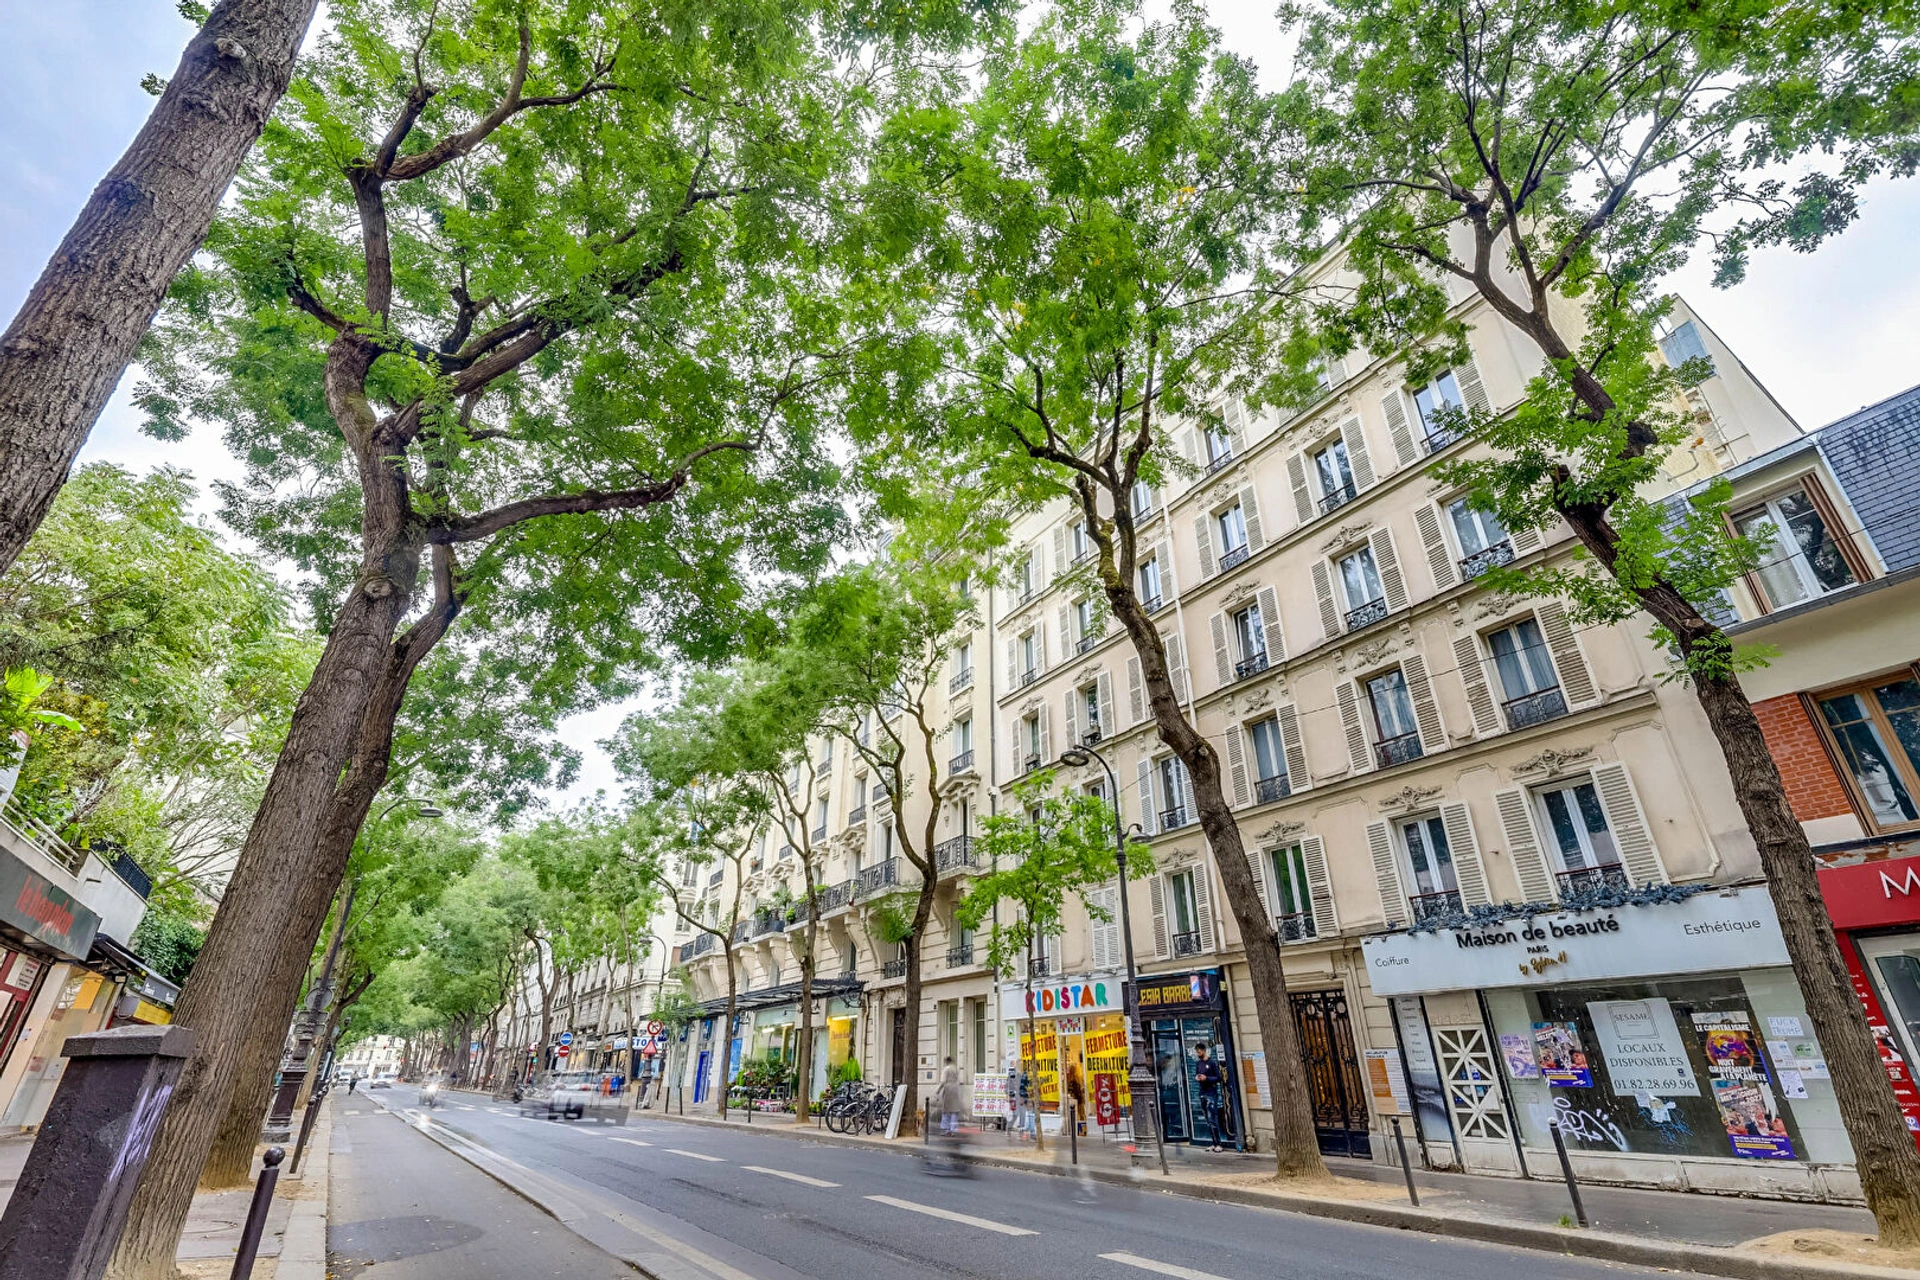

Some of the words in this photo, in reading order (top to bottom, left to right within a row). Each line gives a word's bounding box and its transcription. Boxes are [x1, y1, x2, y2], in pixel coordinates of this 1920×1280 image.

[1455, 930, 1517, 949] Maison
[1522, 925, 1546, 941] de
[1549, 914, 1620, 938] beauté
[1683, 919, 1762, 936] Esthétique
[1527, 945, 1549, 954] PARIS
[1375, 957, 1409, 968] Coiffure
[1703, 1023, 1751, 1032] CAPITALISME
[1086, 1030, 1127, 1055] FERMETURE
[1617, 1043, 1666, 1054] LOCAUX
[1609, 1056, 1684, 1067] DISPONIBLES
[1614, 1079, 1695, 1090] 01.82.28.69.96
